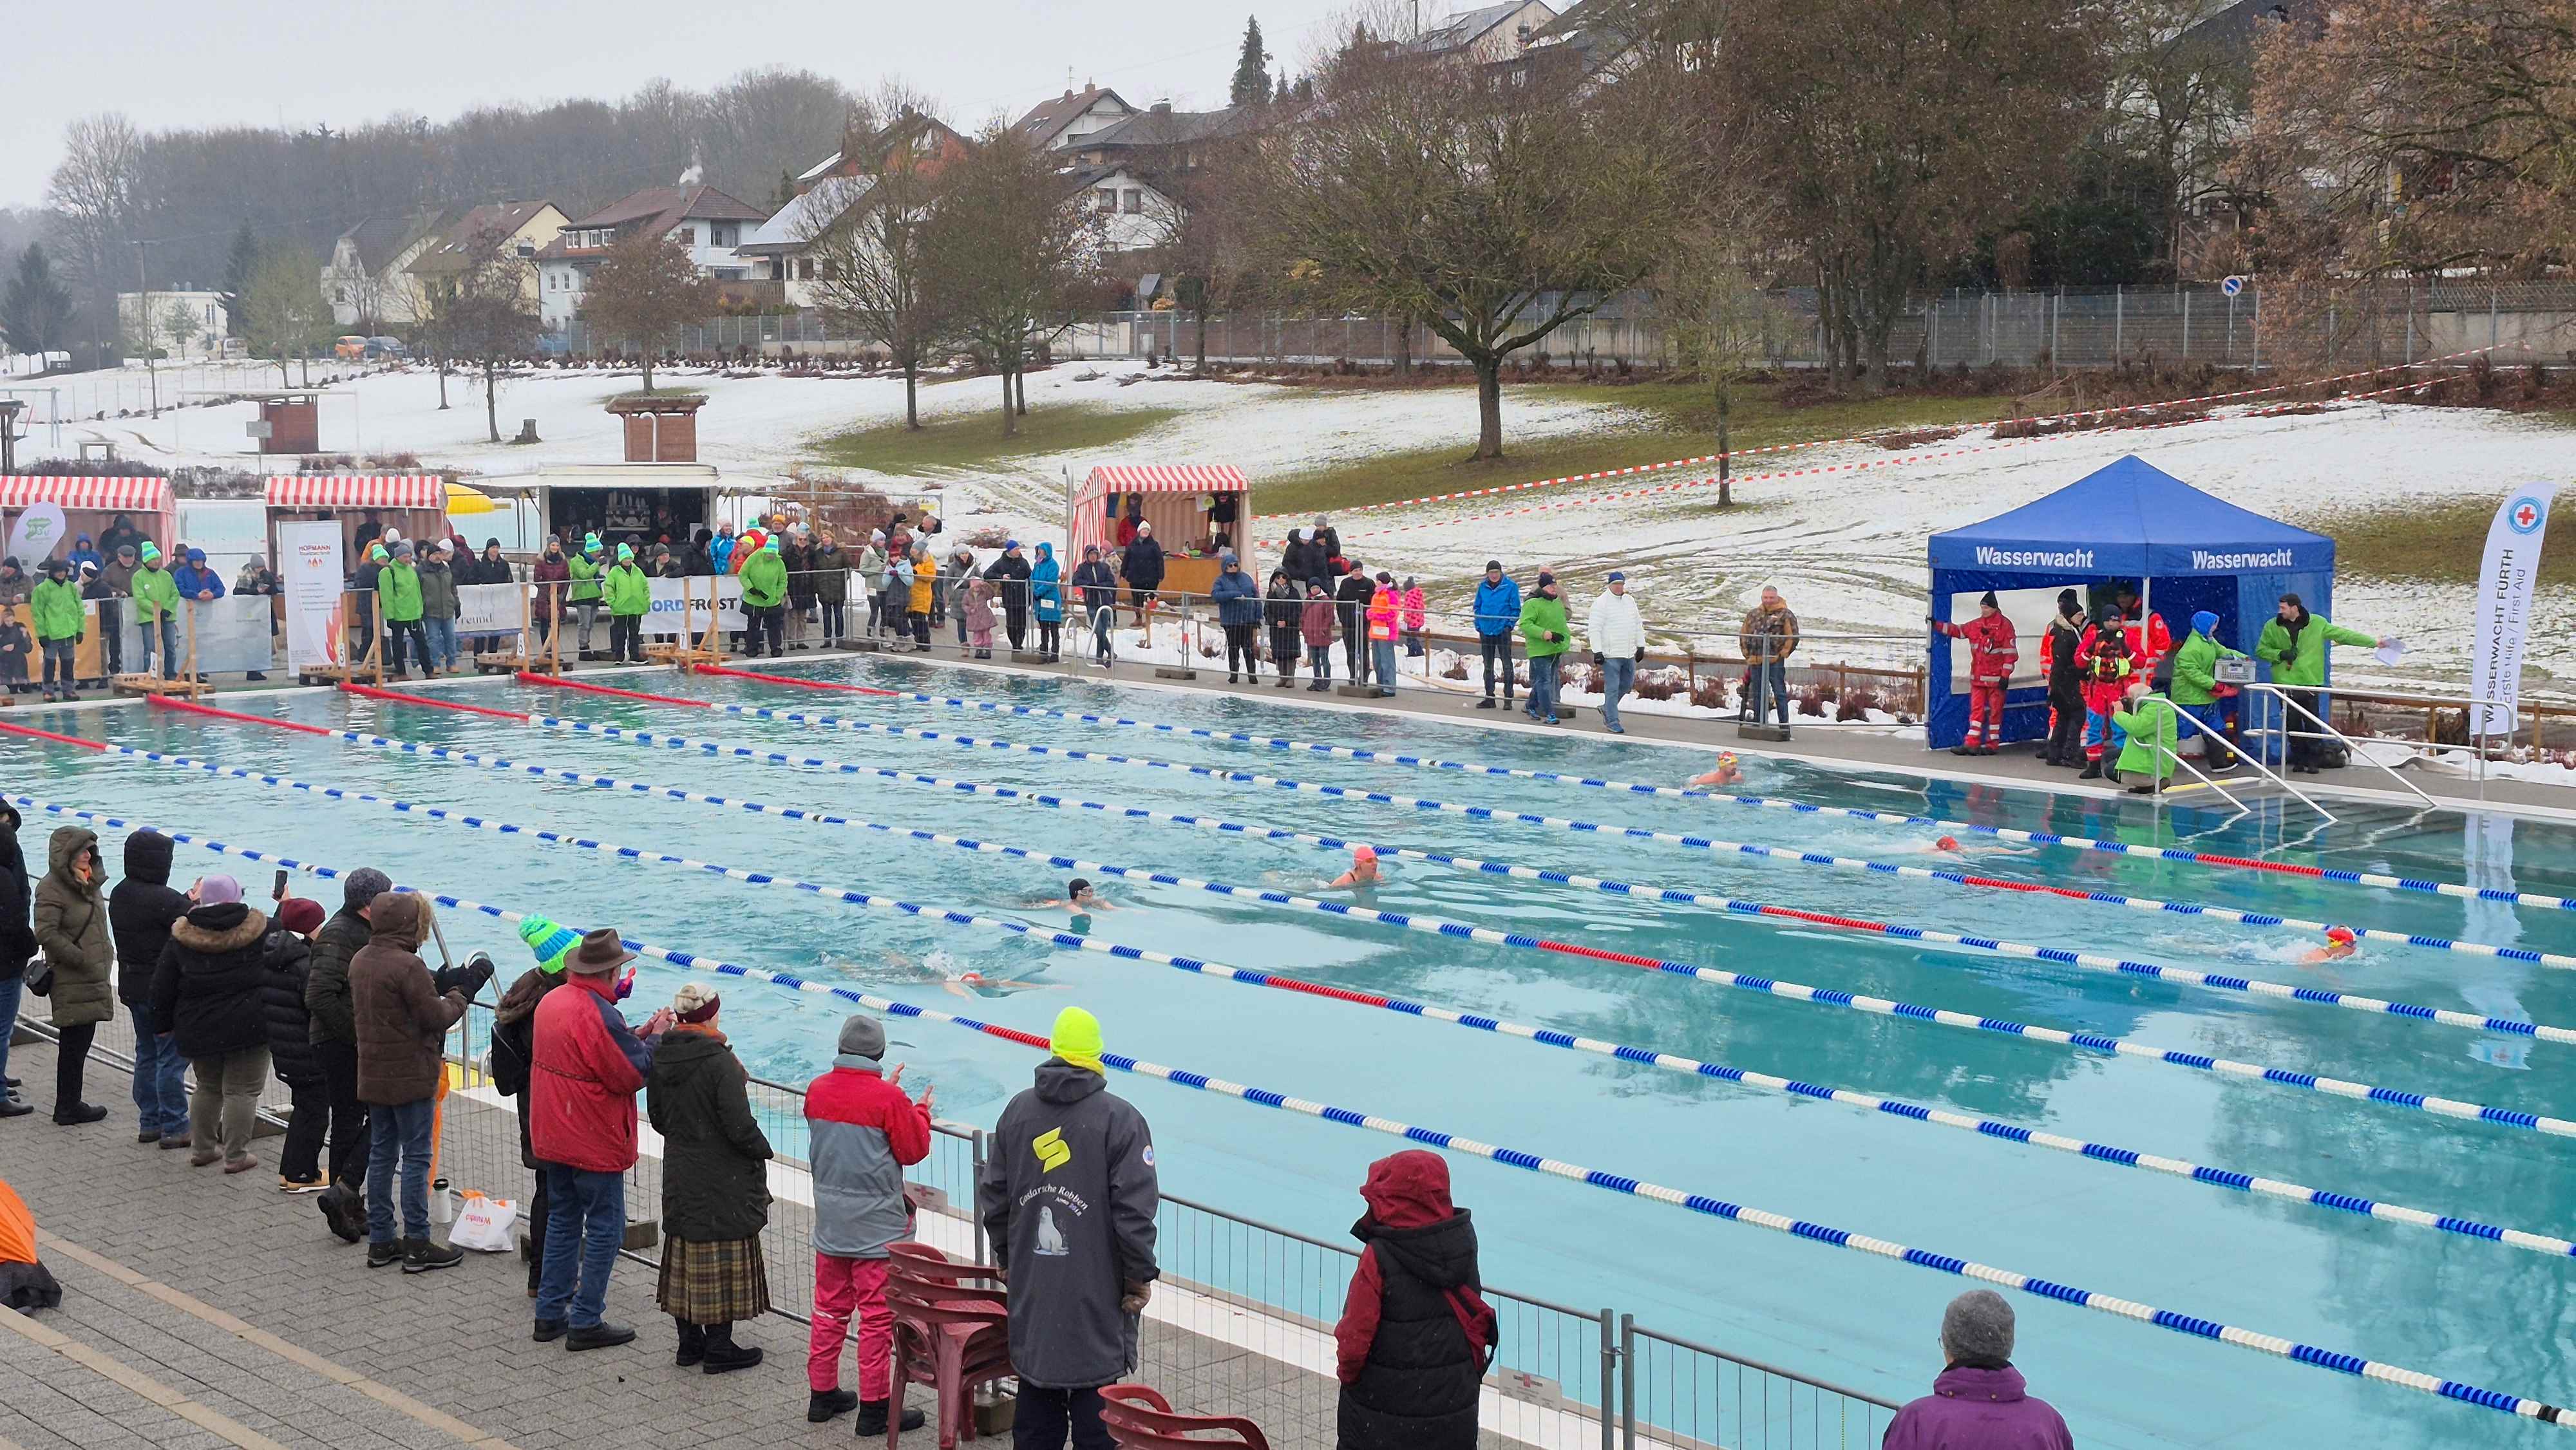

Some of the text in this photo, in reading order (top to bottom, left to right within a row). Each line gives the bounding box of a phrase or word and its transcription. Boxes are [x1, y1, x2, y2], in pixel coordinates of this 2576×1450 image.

[1976, 546, 2093, 568] Wasserwacht
[2192, 548, 2293, 569] Wasserwacht
[2495, 549, 2514, 599] FÜRTH
[2508, 594, 2521, 623] First
[2515, 569, 2526, 590] Aid
[681, 634, 685, 646] 7
[339, 649, 345, 663] 5
[1019, 1183, 1088, 1210] Goslarsche Robben
